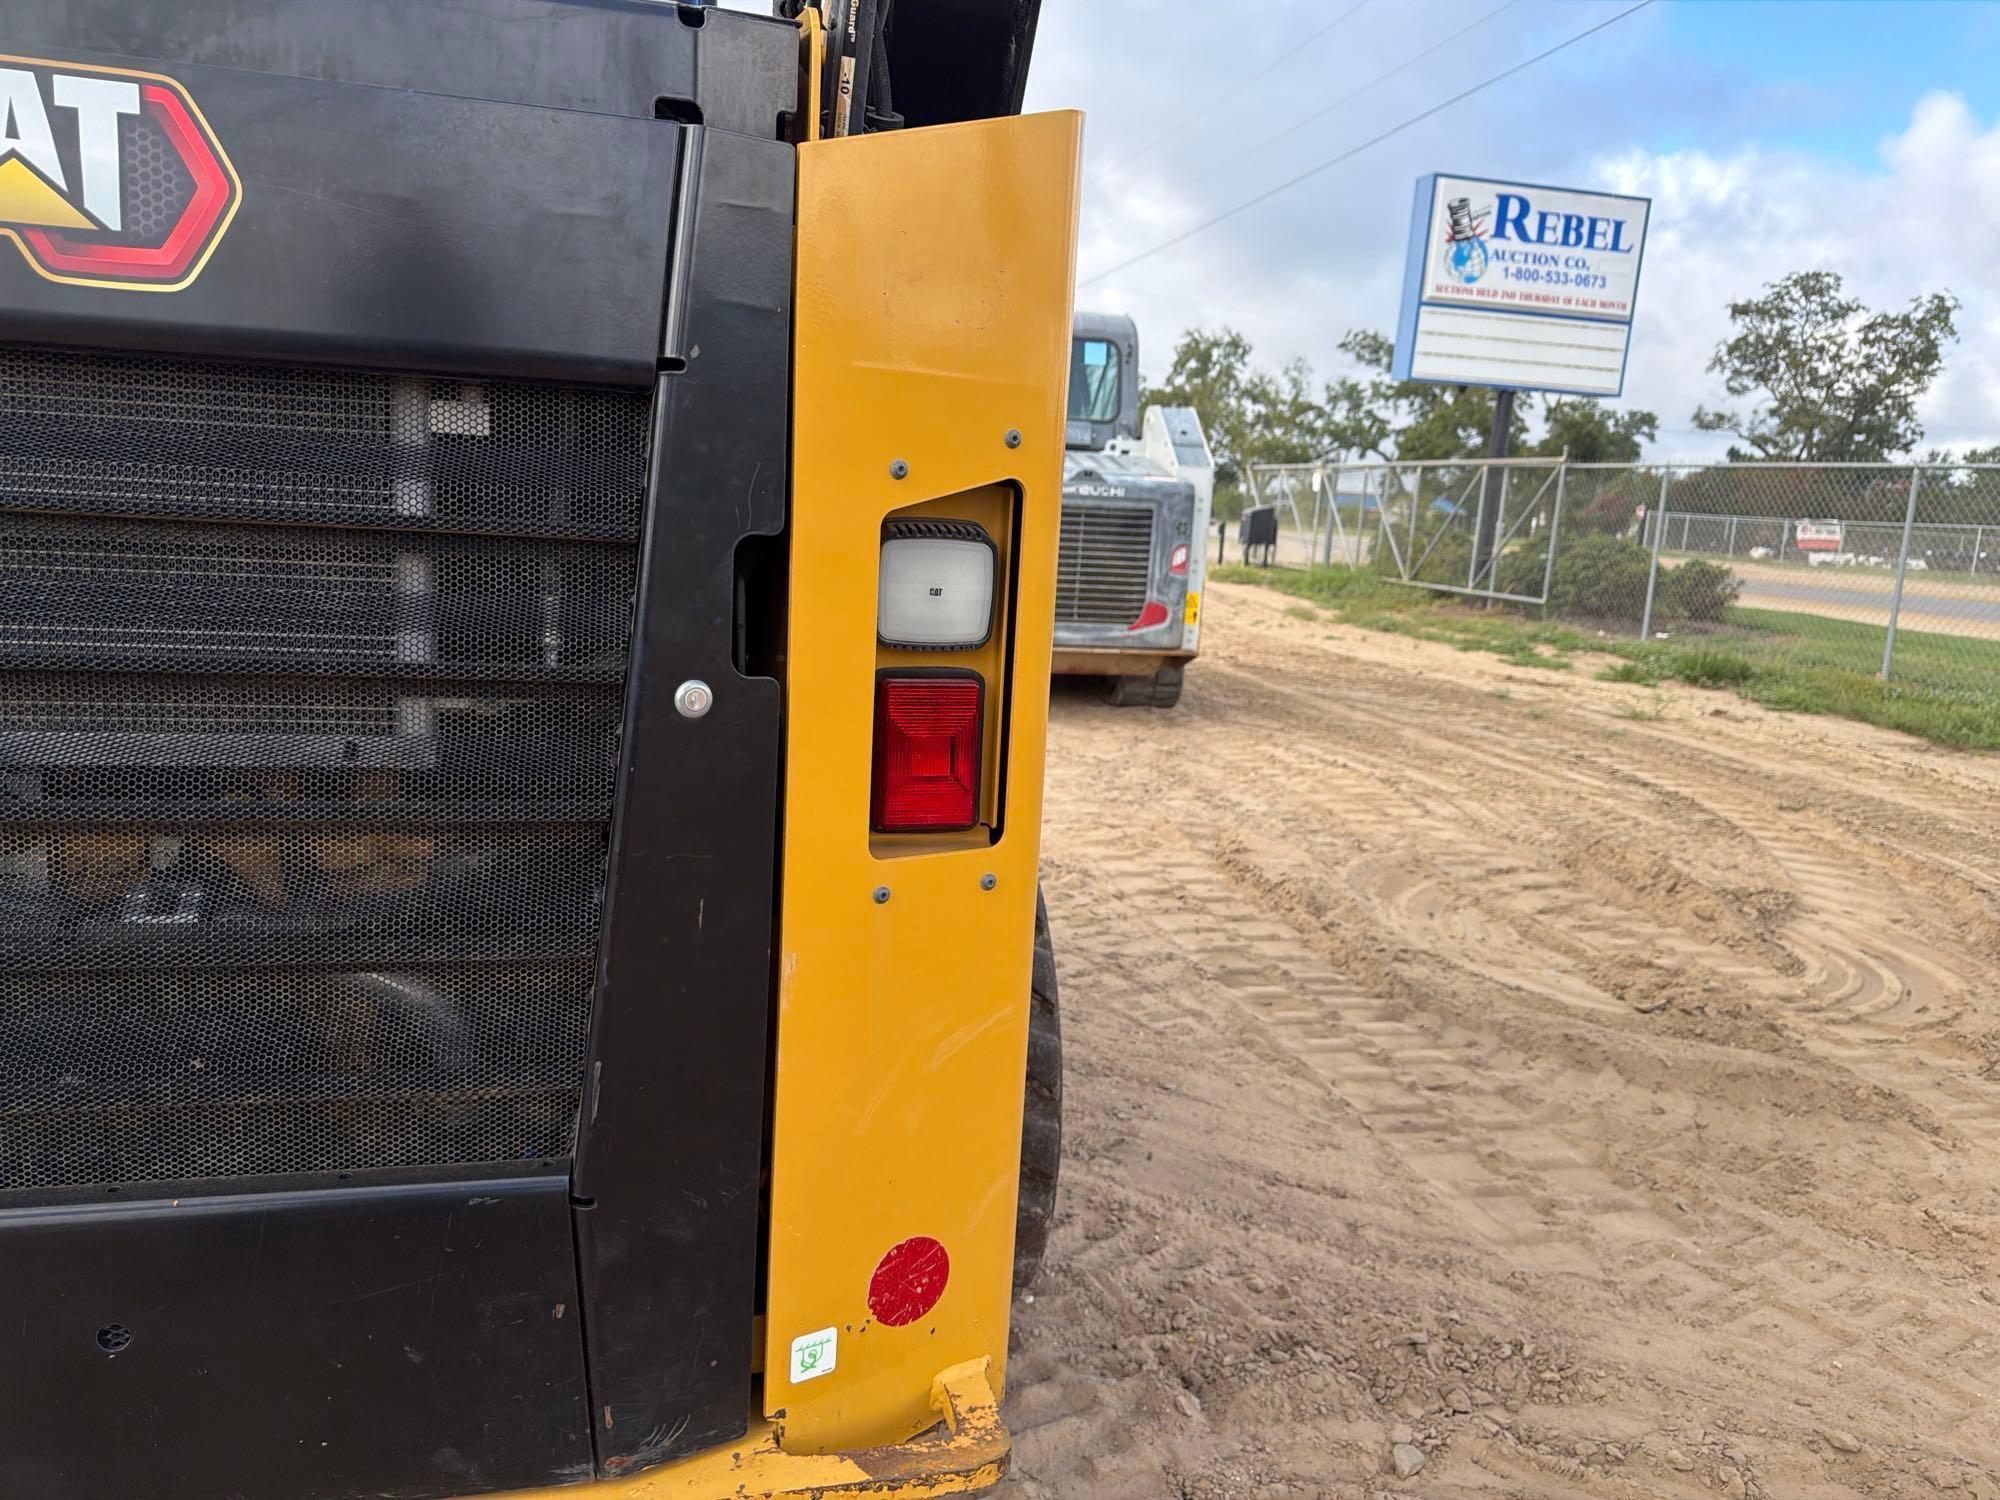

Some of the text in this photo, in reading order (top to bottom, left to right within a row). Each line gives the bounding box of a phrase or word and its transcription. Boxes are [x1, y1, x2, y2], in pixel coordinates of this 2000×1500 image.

[1490, 193, 1634, 254] REBEL
[1490, 249, 1591, 271] AUCTION CO.
[1503, 266, 1607, 289] 1-800-533-0673
[929, 587, 943, 596] CAT
